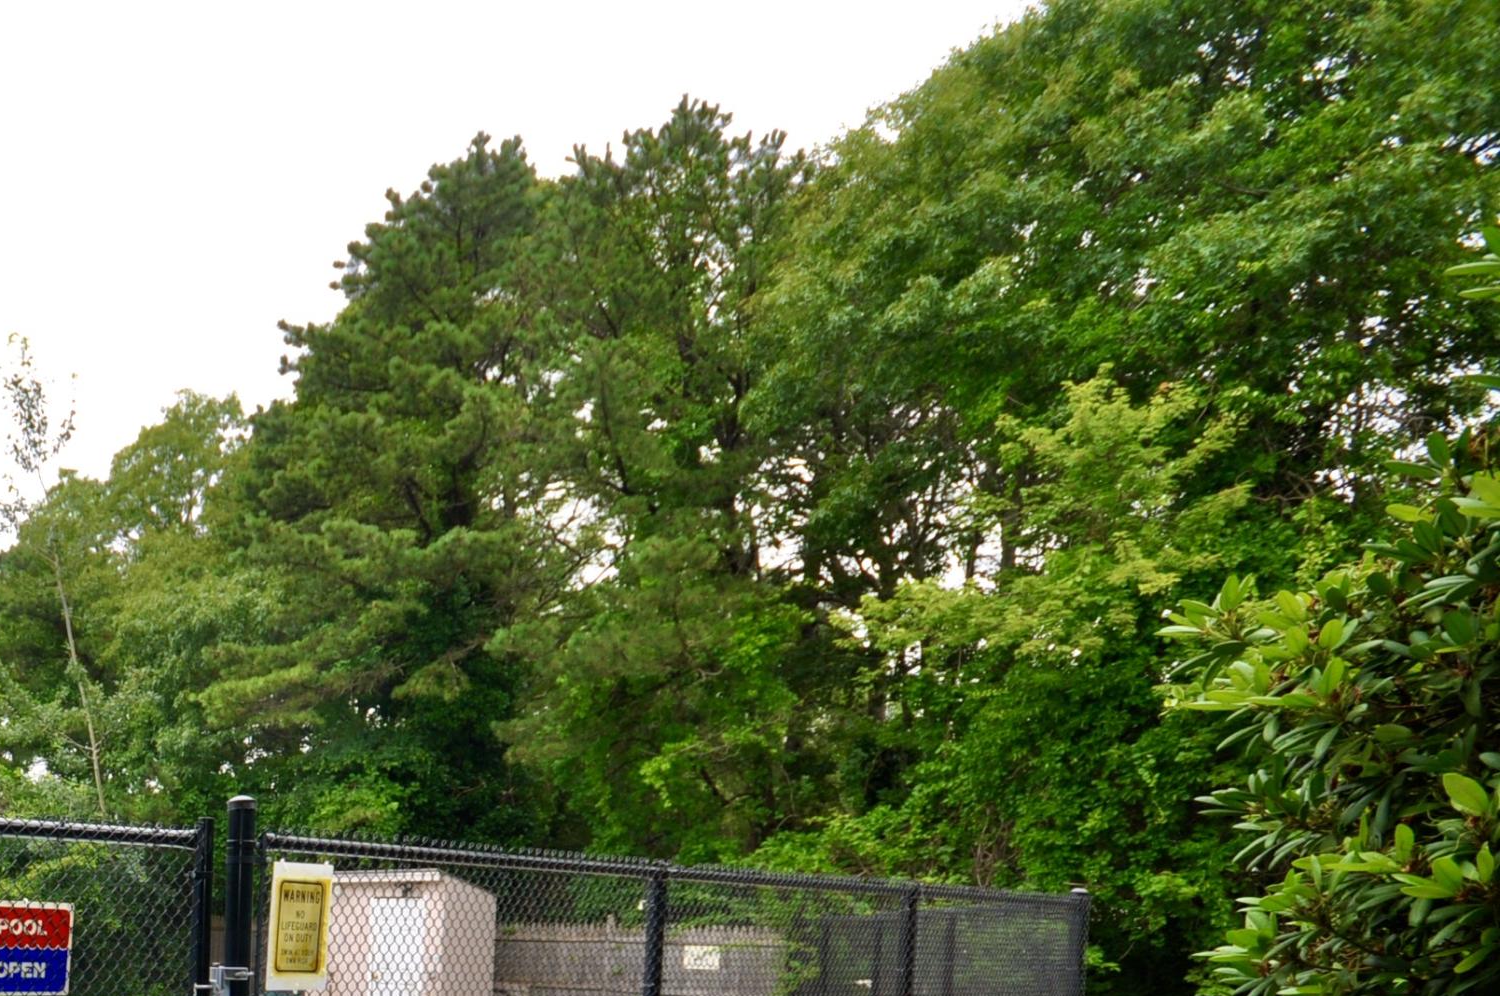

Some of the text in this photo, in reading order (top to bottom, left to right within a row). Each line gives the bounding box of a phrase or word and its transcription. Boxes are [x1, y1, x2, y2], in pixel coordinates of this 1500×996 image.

[283, 889, 320, 904] WARNING
[296, 910, 306, 919] NO
[281, 921, 317, 931] LIFEGUARD
[284, 933, 293, 942] ON
